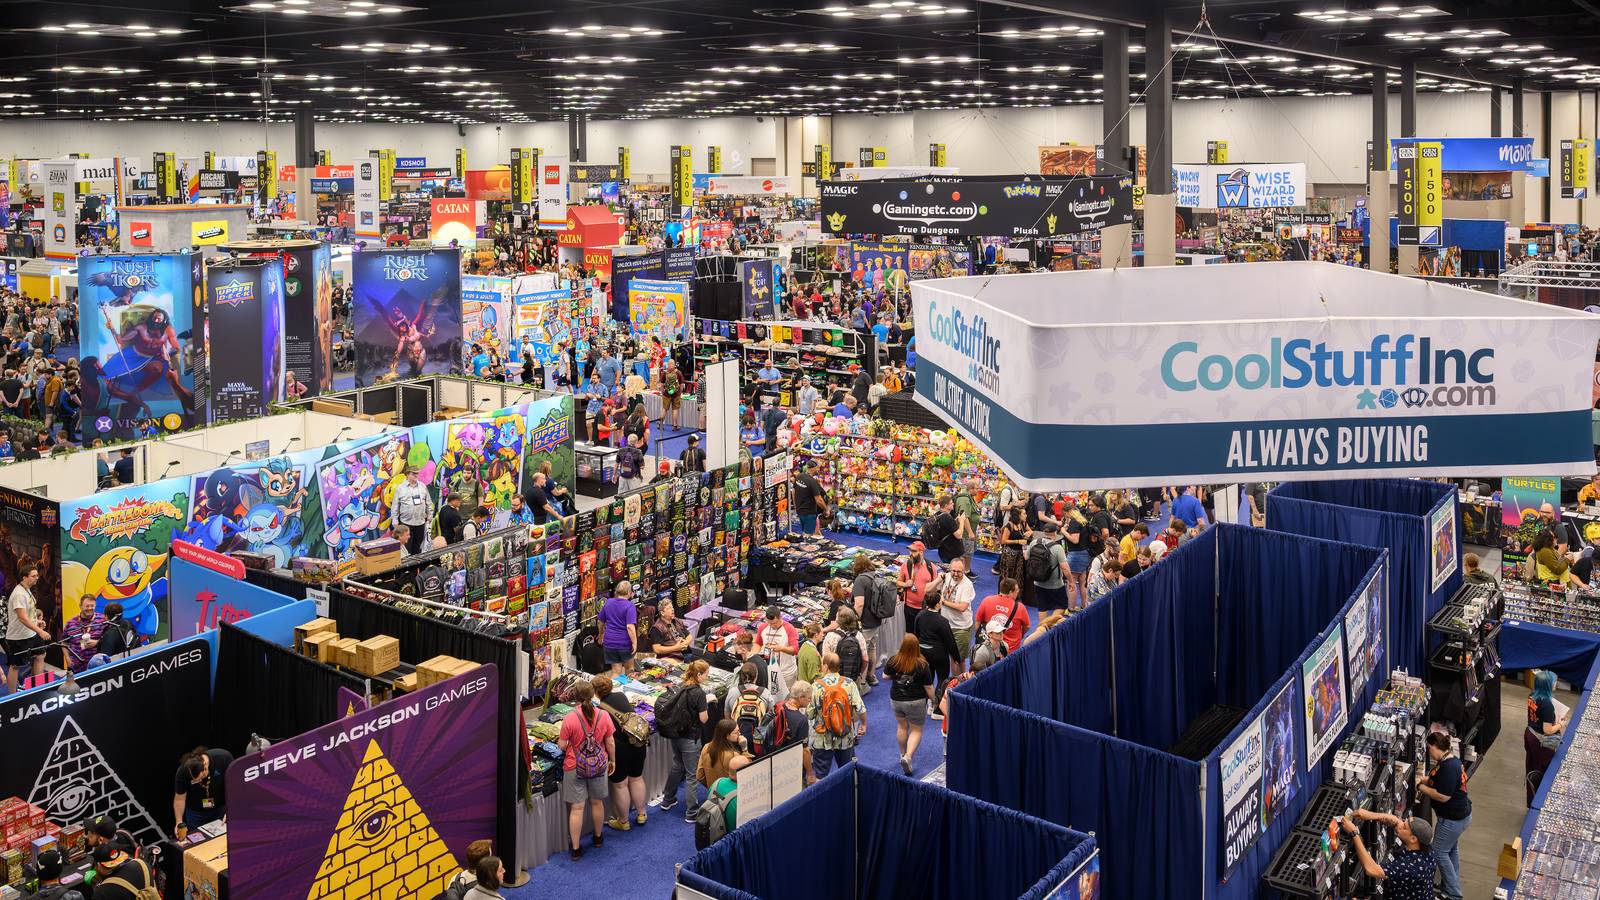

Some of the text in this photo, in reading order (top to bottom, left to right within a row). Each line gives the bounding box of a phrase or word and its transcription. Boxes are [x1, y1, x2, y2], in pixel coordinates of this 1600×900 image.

[1179, 171, 1200, 182] WACKY
[1254, 171, 1291, 184] WISE
[823, 185, 858, 195] MAGIC
[1045, 185, 1063, 194] MAGIC
[1250, 184, 1296, 196] WIZARD
[1403, 168, 1413, 215] 1500
[1426, 168, 1435, 215] 1500
[1180, 195, 1200, 207] GAMES
[1252, 196, 1295, 207] GAMES
[436, 203, 471, 214] CATAN
[886, 203, 974, 217] Gamingetc.com
[898, 225, 960, 236] True Dungeon
[1013, 226, 1039, 235] Plush
[559, 234, 582, 244] CATAN
[384, 253, 426, 269] RUSH
[585, 254, 609, 265] CATAN
[111, 260, 156, 274] RUSH
[217, 285, 251, 296] UPPER
[928, 300, 1001, 374] CoolStuffInc
[1160, 333, 1495, 391] CoolStuffInc
[934, 371, 947, 408] COOL
[964, 391, 972, 427] IN
[1426, 384, 1496, 408] .com
[535, 421, 566, 441] UPPER
[1226, 424, 1428, 468] ALWAYS BUYING
[1507, 478, 1556, 492] TURTLES
[9, 648, 202, 724] JACKSON GAMES
[243, 676, 488, 784] STEVE JACKSON GAMES
[1226, 788, 1258, 842] ALWAYS
[1226, 814, 1258, 868] BUYING
